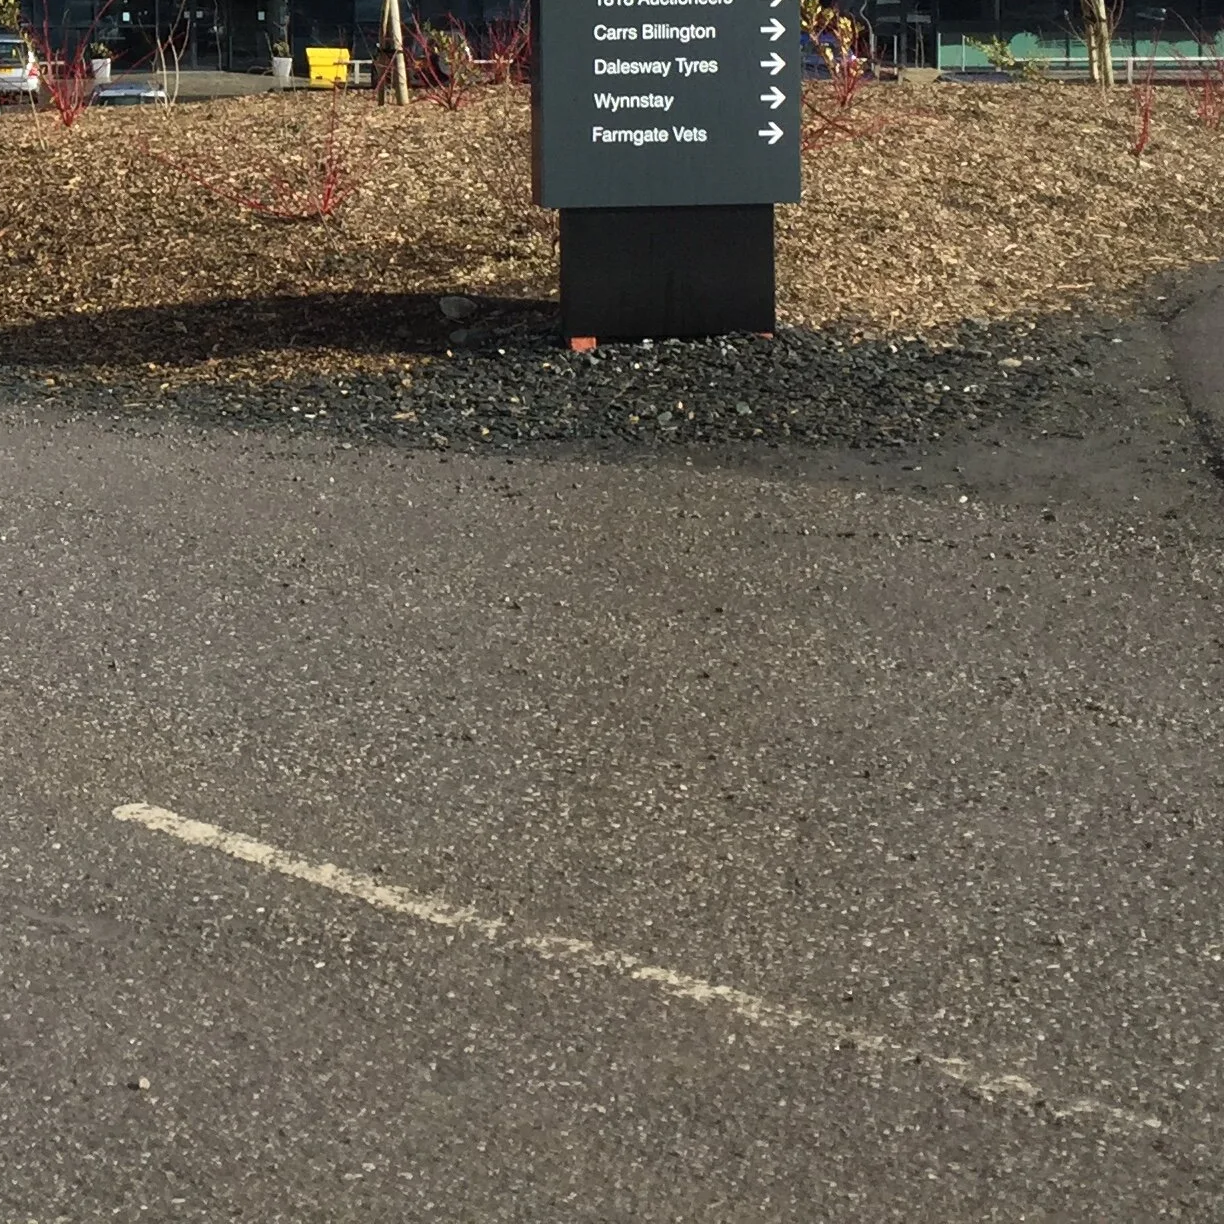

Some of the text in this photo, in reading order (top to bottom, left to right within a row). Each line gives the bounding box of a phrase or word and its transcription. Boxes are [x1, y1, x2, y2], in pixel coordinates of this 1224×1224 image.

[593, 23, 716, 43] Carrs Billington
[594, 57, 718, 77] Dalesway Tyres
[594, 92, 674, 112] Wynnstay
[592, 126, 707, 146] Farmgate Vets
